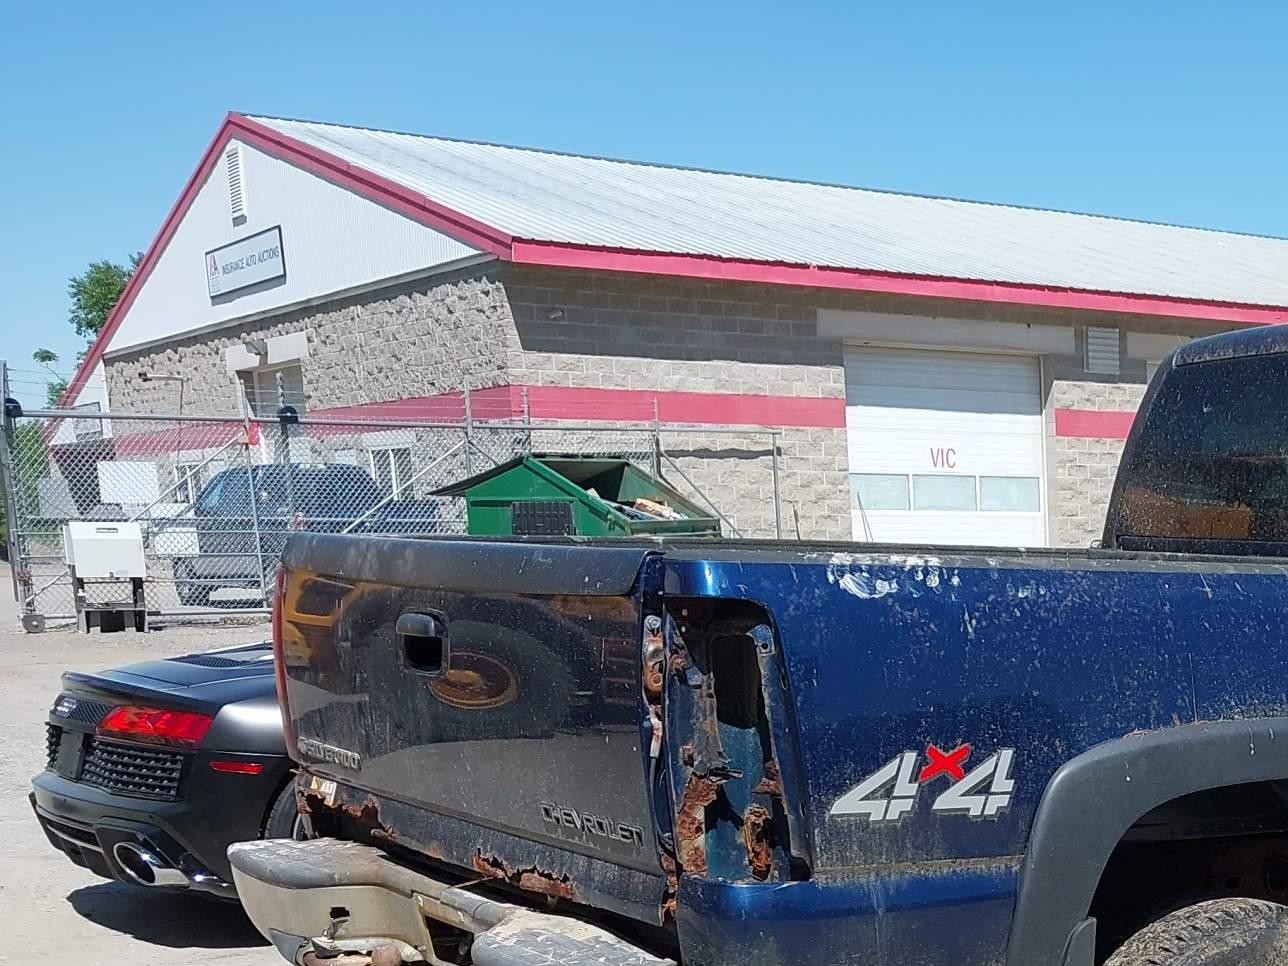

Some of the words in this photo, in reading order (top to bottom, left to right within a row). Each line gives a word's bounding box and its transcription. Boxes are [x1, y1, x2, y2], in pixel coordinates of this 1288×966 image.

[246, 254, 257, 267] AUTO
[257, 246, 280, 263] AUCTIONS
[930, 447, 956, 469] VIC
[541, 802, 644, 849] CHEVROLET
